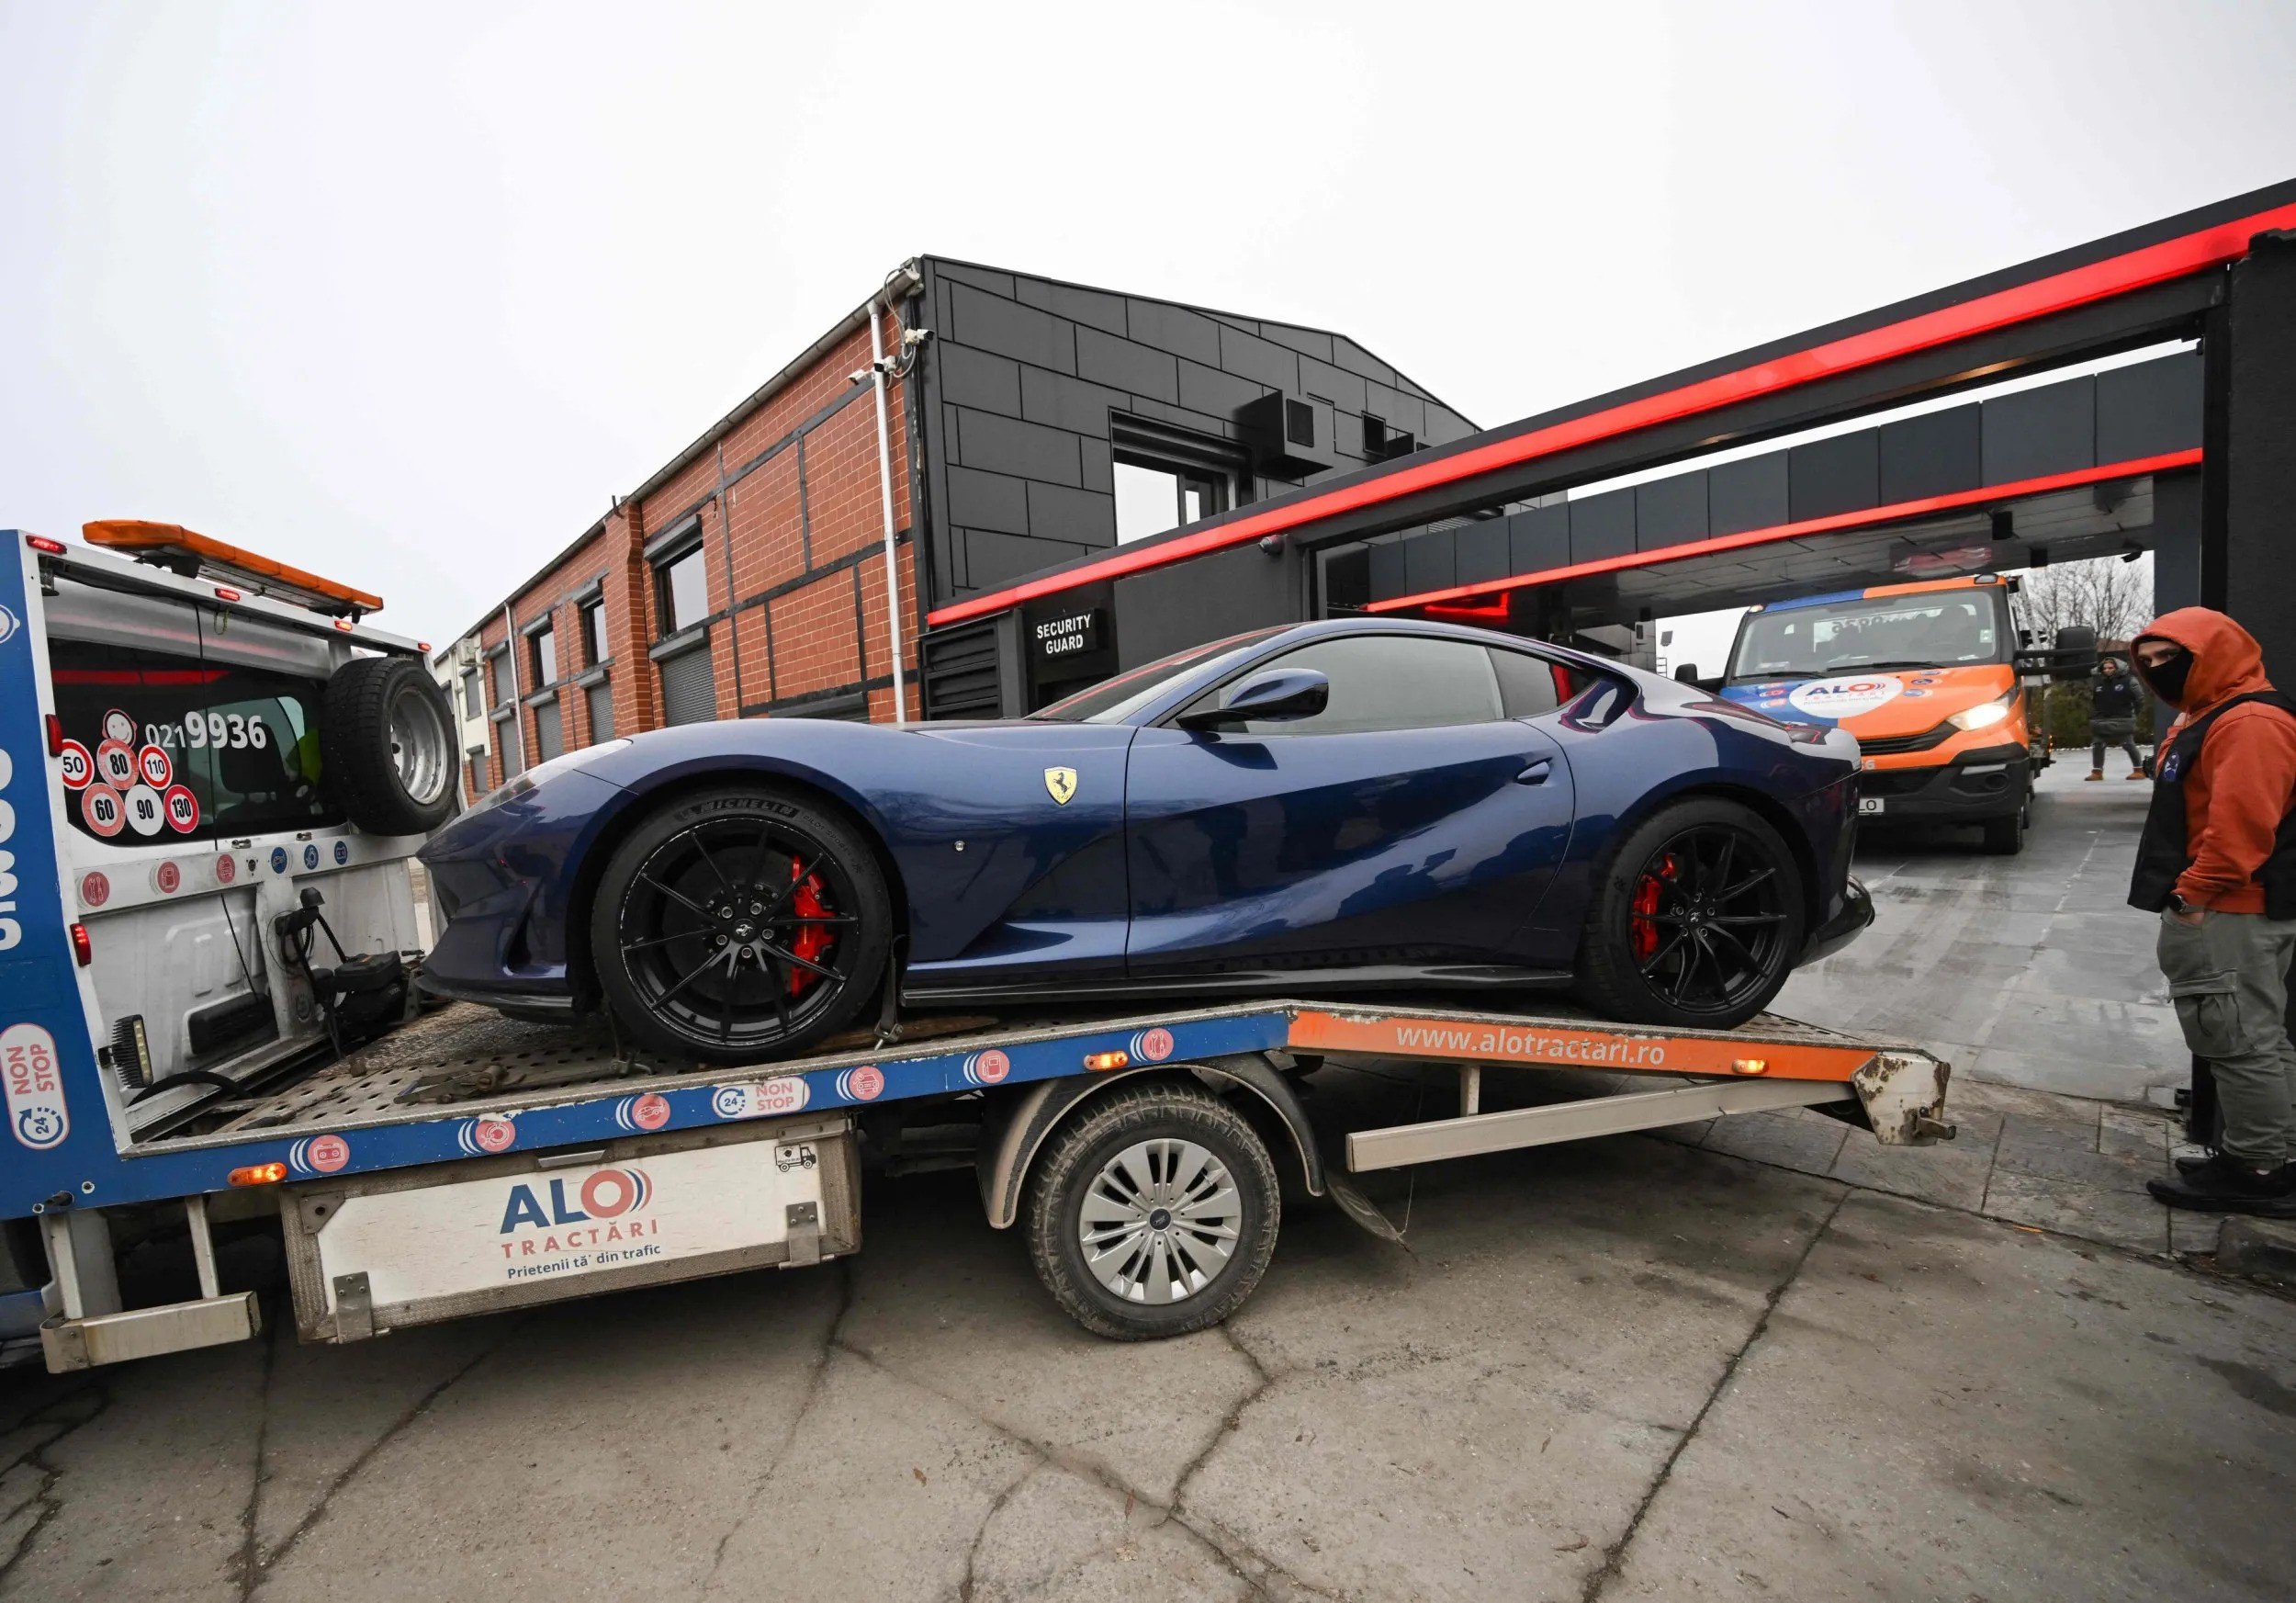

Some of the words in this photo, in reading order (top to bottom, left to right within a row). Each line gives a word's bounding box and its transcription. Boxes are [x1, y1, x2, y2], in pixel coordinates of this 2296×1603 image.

[1036, 614, 1091, 639] SECURITY
[1045, 634, 1084, 654] GUARD
[1806, 683, 1875, 696] ALO
[62, 756, 84, 773] 50
[109, 753, 129, 775] 80
[147, 759, 165, 774] 110
[95, 798, 115, 820] 60
[136, 799, 154, 819] 90
[172, 797, 192, 818] 130
[700, 797, 794, 816] MICHELIN
[1396, 1026, 1665, 1066] www.alotractari.ro
[6, 1045, 32, 1096] NON
[29, 1044, 55, 1092] STOP
[755, 1082, 794, 1098] NON
[724, 1097, 737, 1107] 24
[756, 1096, 794, 1112] STOP
[34, 1116, 50, 1135] 24
[500, 1168, 636, 1235] ALO
[501, 1219, 658, 1259] TRACTĂRI
[507, 1259, 570, 1280] Prietenii
[597, 1249, 620, 1265] din
[623, 1243, 662, 1260] trafic
